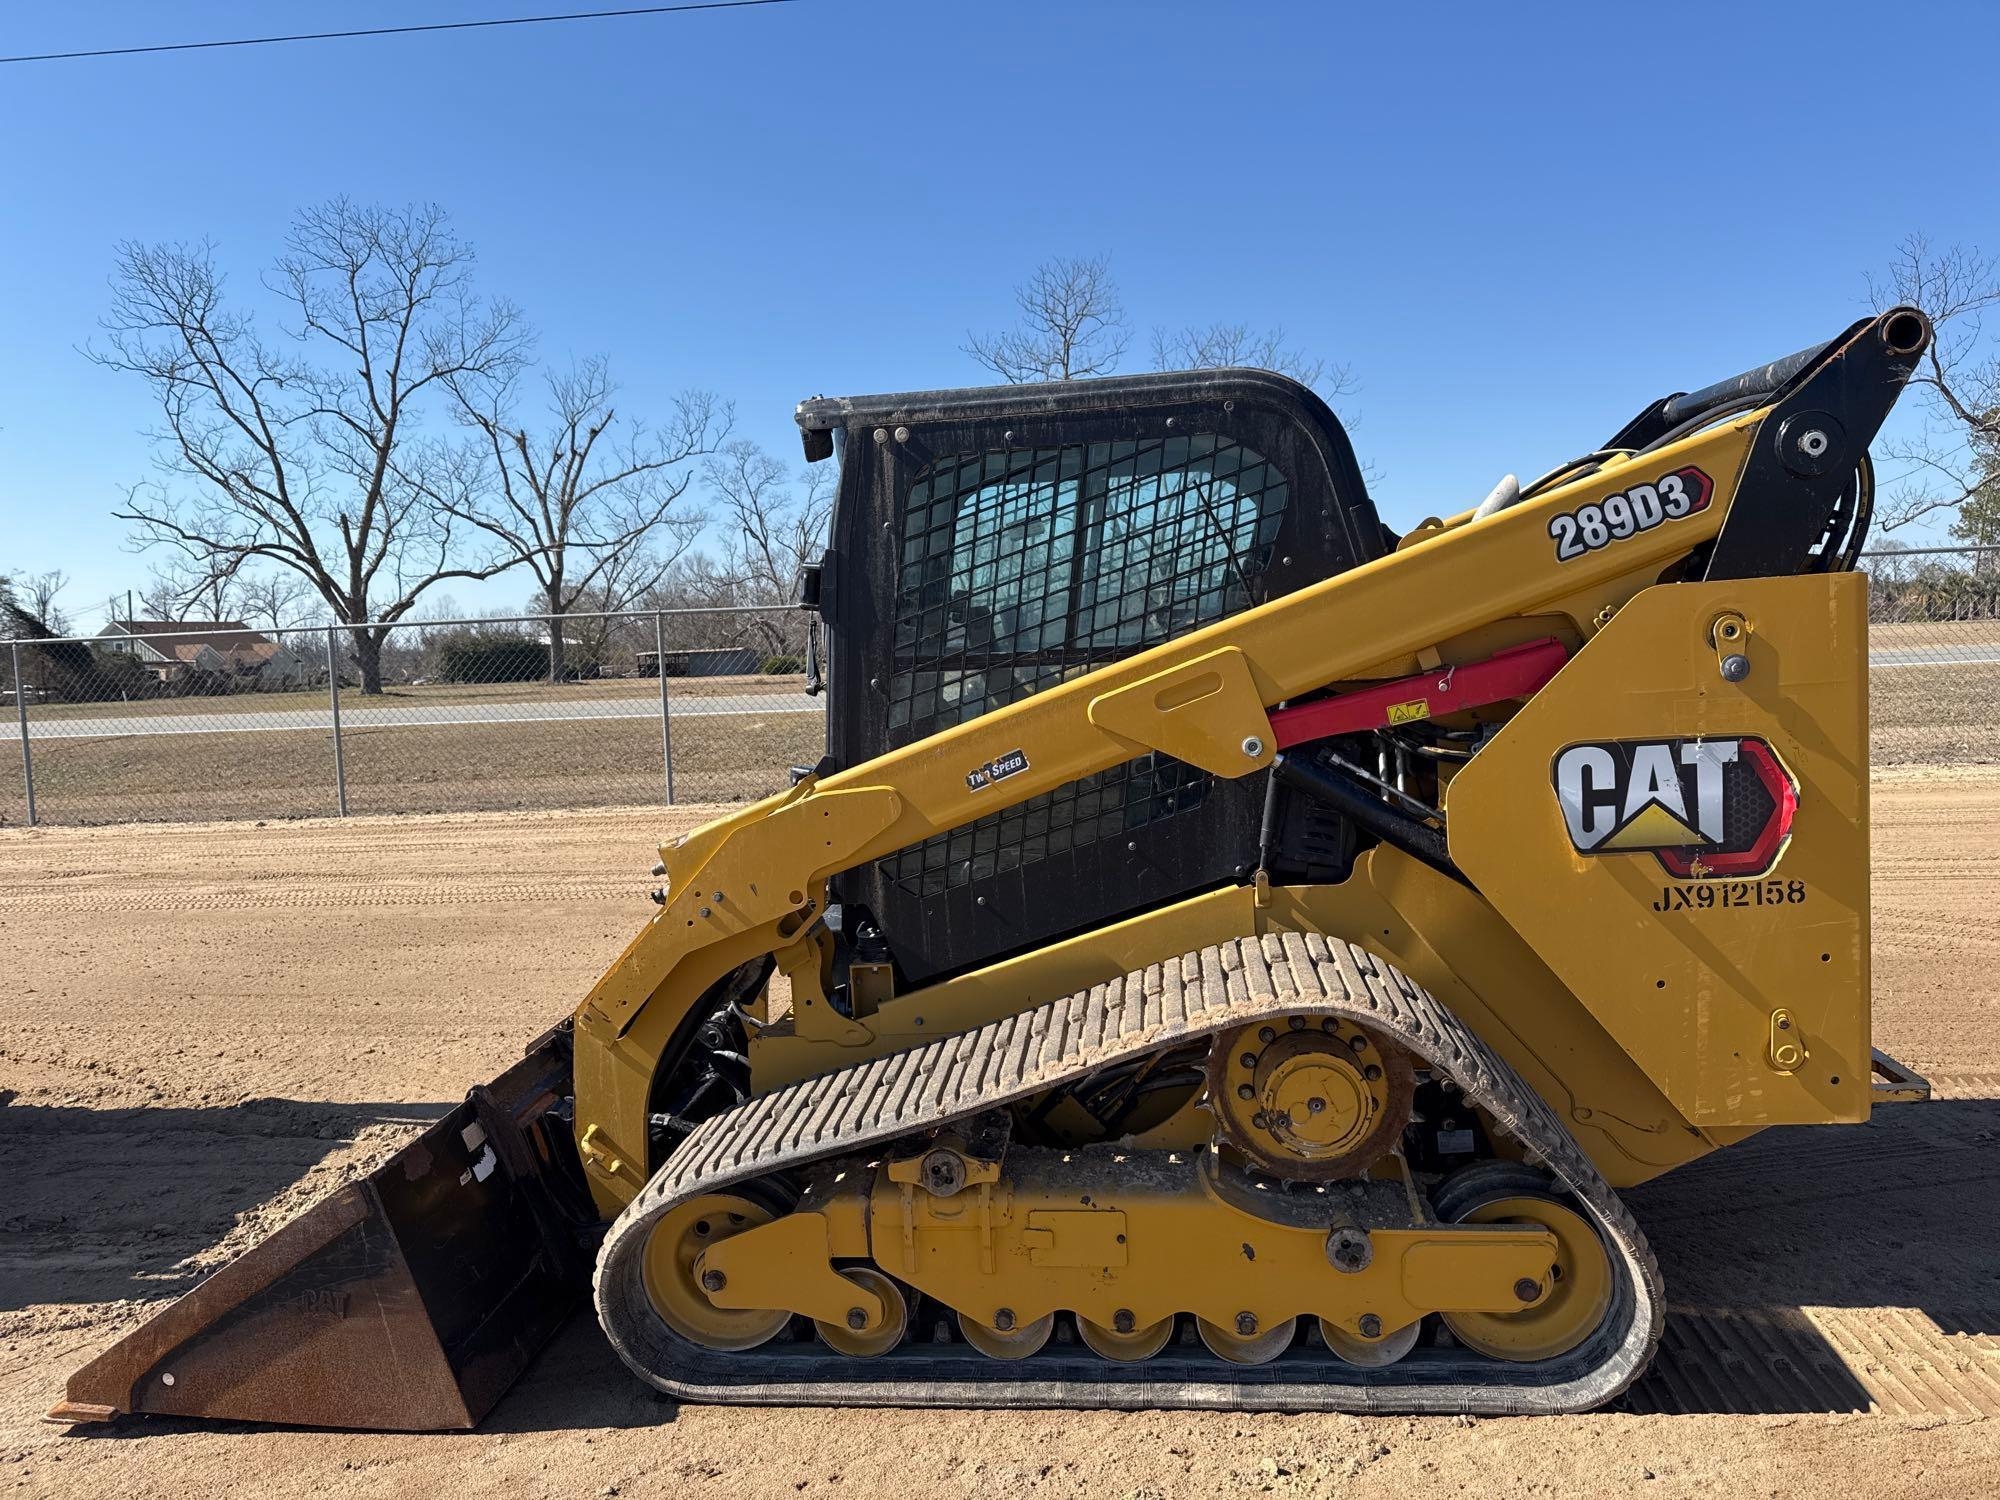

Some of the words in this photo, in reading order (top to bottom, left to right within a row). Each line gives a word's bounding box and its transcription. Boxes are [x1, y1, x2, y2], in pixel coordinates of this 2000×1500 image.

[1550, 475, 1691, 559] 289D3
[992, 756, 1022, 777] SPEED
[1557, 741, 1739, 850] CAT
[1653, 879, 1806, 912] JX912158
